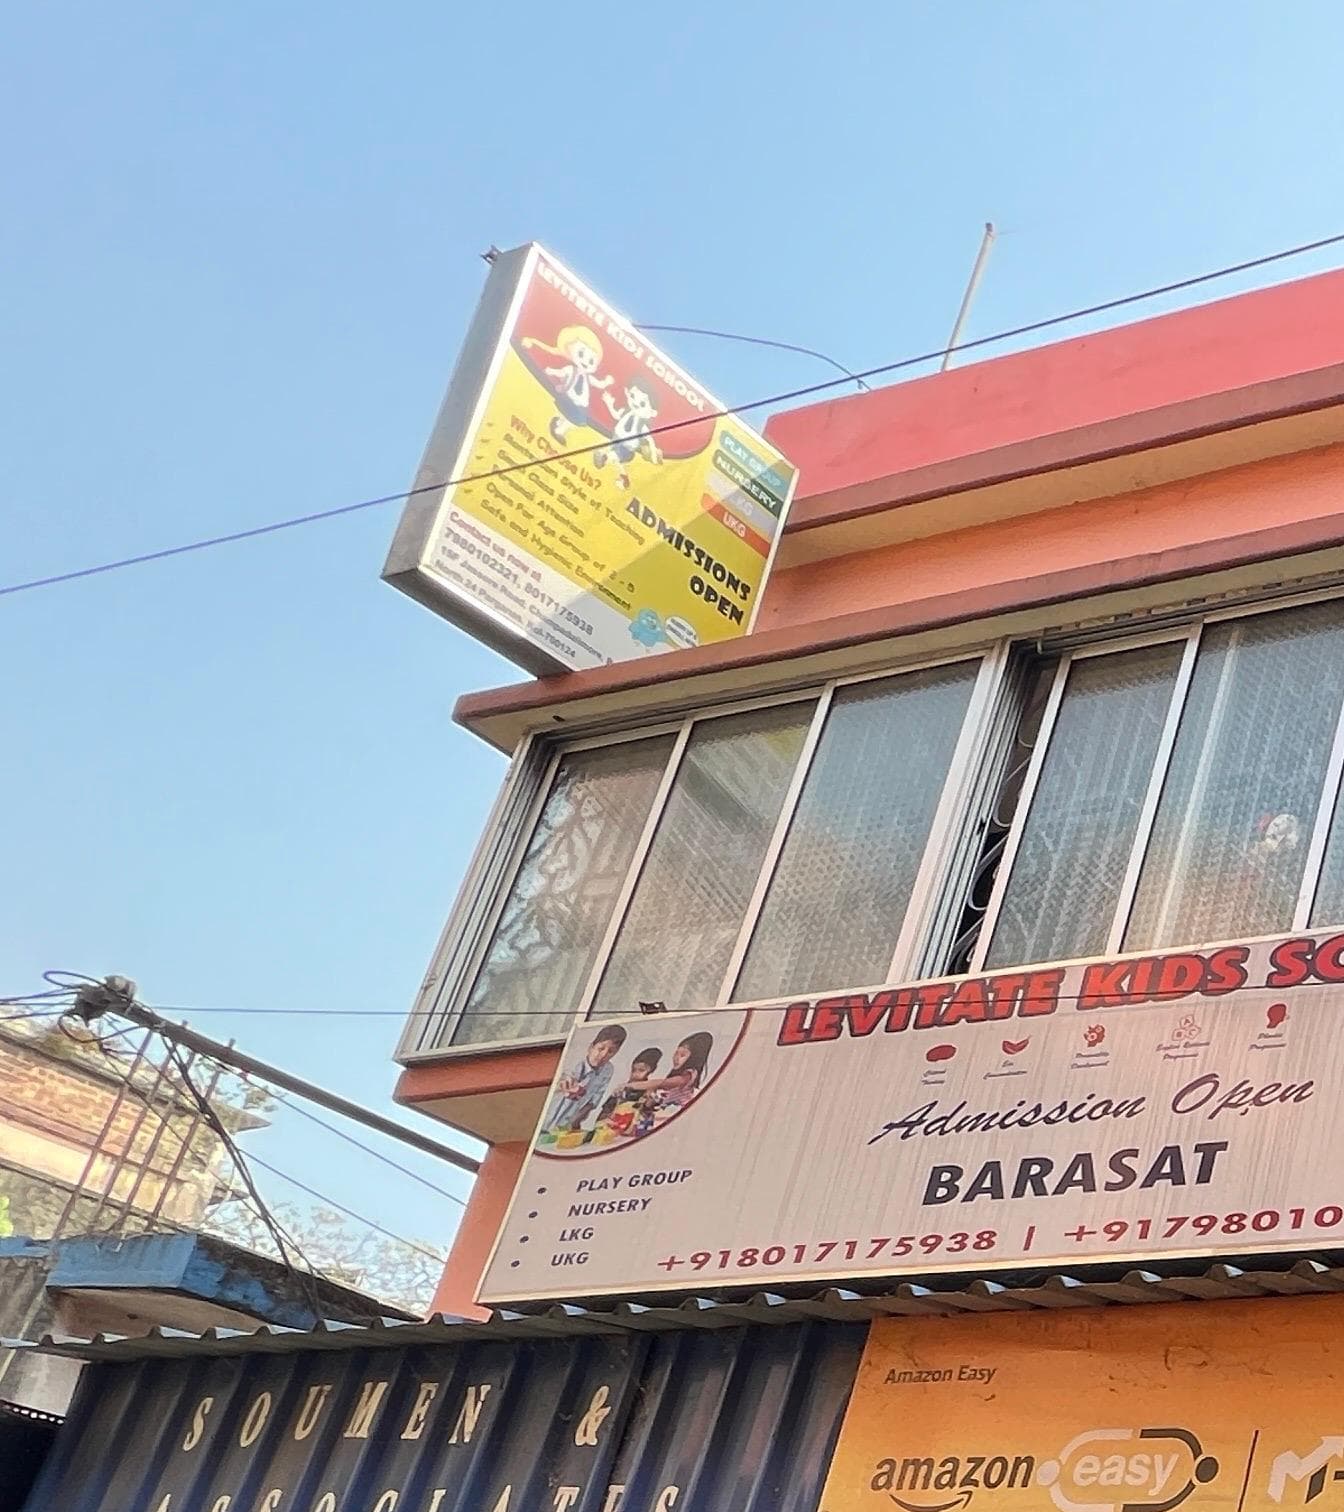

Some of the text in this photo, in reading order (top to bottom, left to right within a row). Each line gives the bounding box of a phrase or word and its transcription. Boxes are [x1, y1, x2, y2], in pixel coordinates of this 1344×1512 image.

[626, 498, 750, 601] ADMISSIONS
[690, 575, 744, 626] OPEN
[778, 969, 1066, 1046] LEVITATE
[1076, 947, 1250, 1012] KIDS
[868, 1074, 1313, 1147] Admission Open
[576, 1169, 693, 1193] PLAY GROUP
[922, 1141, 1229, 1206] BARASAT
[568, 1198, 652, 1218] NURSERY
[559, 1227, 594, 1242] LKG
[658, 1230, 998, 1272] +918017175938
[551, 1252, 589, 1267] UKG
[884, 1365, 997, 1384] Amazon Easy
[182, 1382, 612, 1452] SOUMEN &
[870, 1452, 1179, 1495] amazon easy
